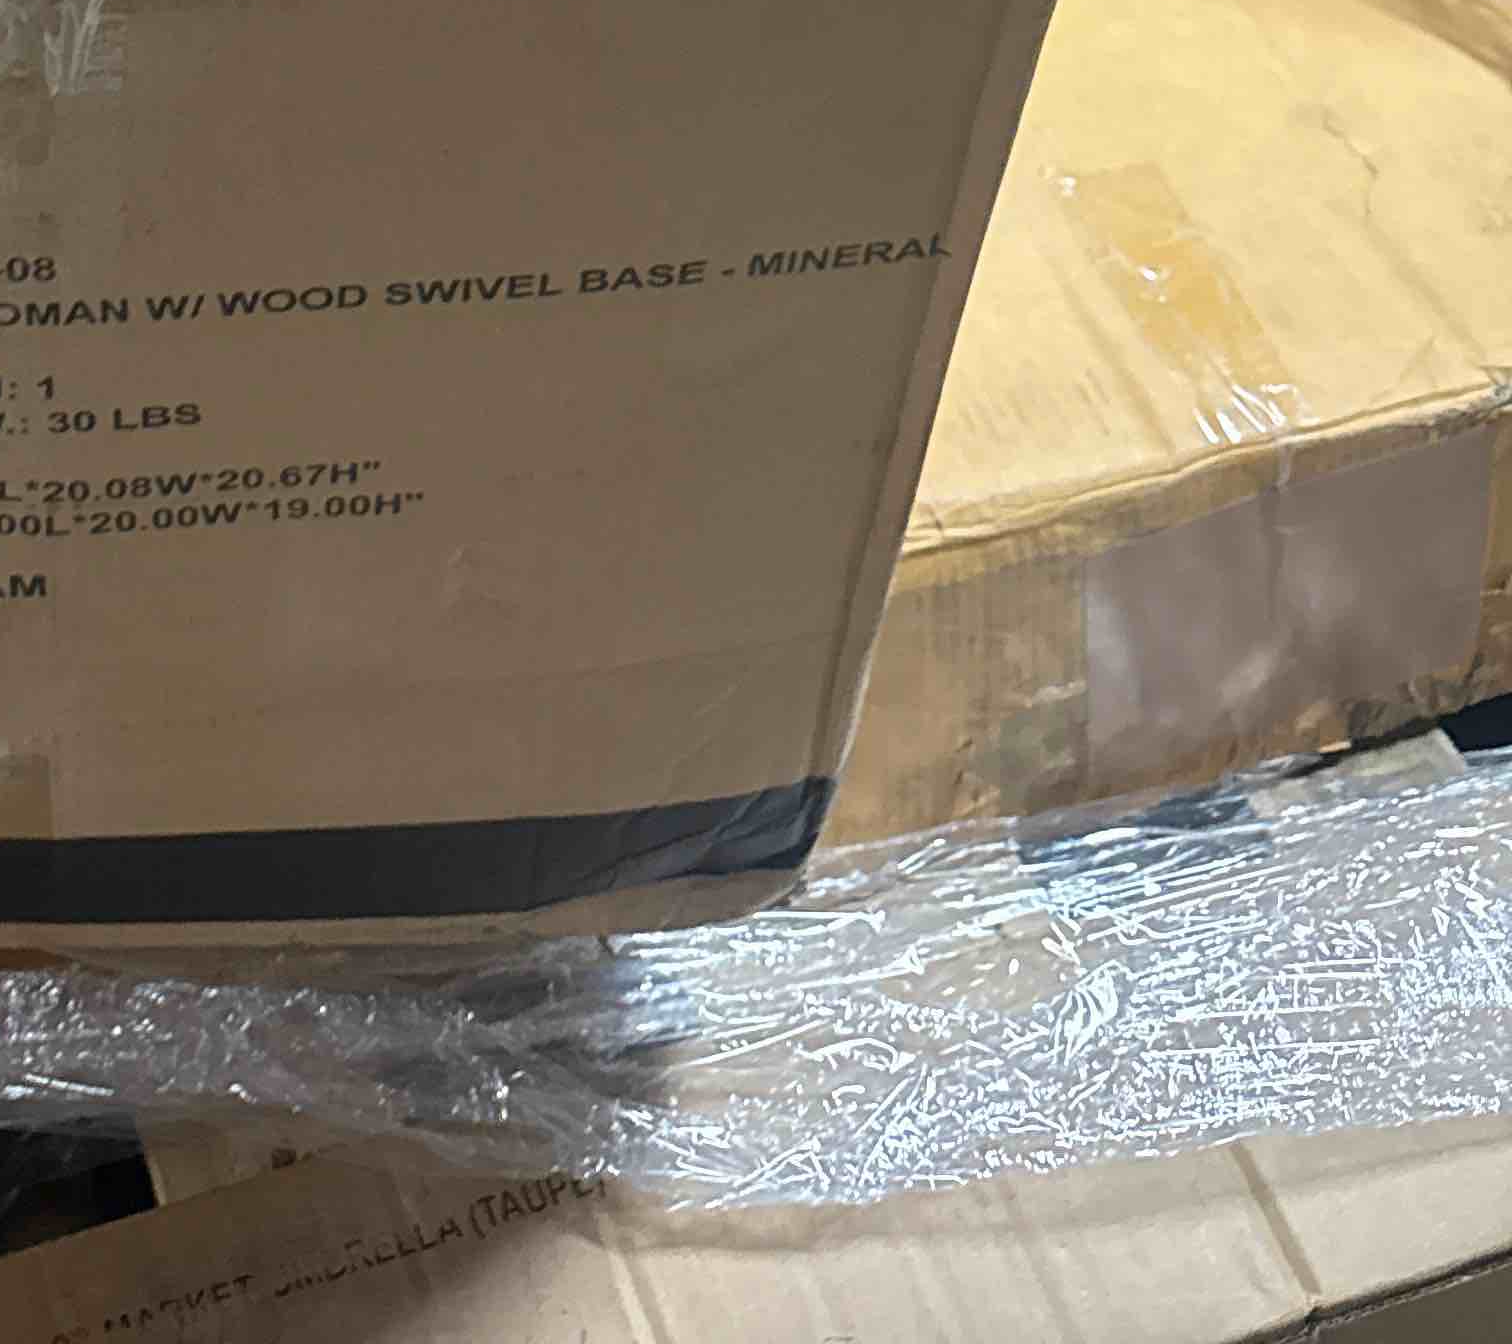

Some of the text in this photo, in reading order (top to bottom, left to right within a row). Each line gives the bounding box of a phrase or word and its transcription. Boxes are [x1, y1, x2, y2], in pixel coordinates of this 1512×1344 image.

[146, 293, 202, 322] W/
[218, 285, 368, 316] WOOD
[384, 272, 562, 306] SWIVEL
[579, 260, 708, 295] BASE
[747, 233, 950, 276] MINERAL
[37, 376, 54, 399] 1
[48, 410, 96, 435] 30
[113, 403, 201, 430] LBS
